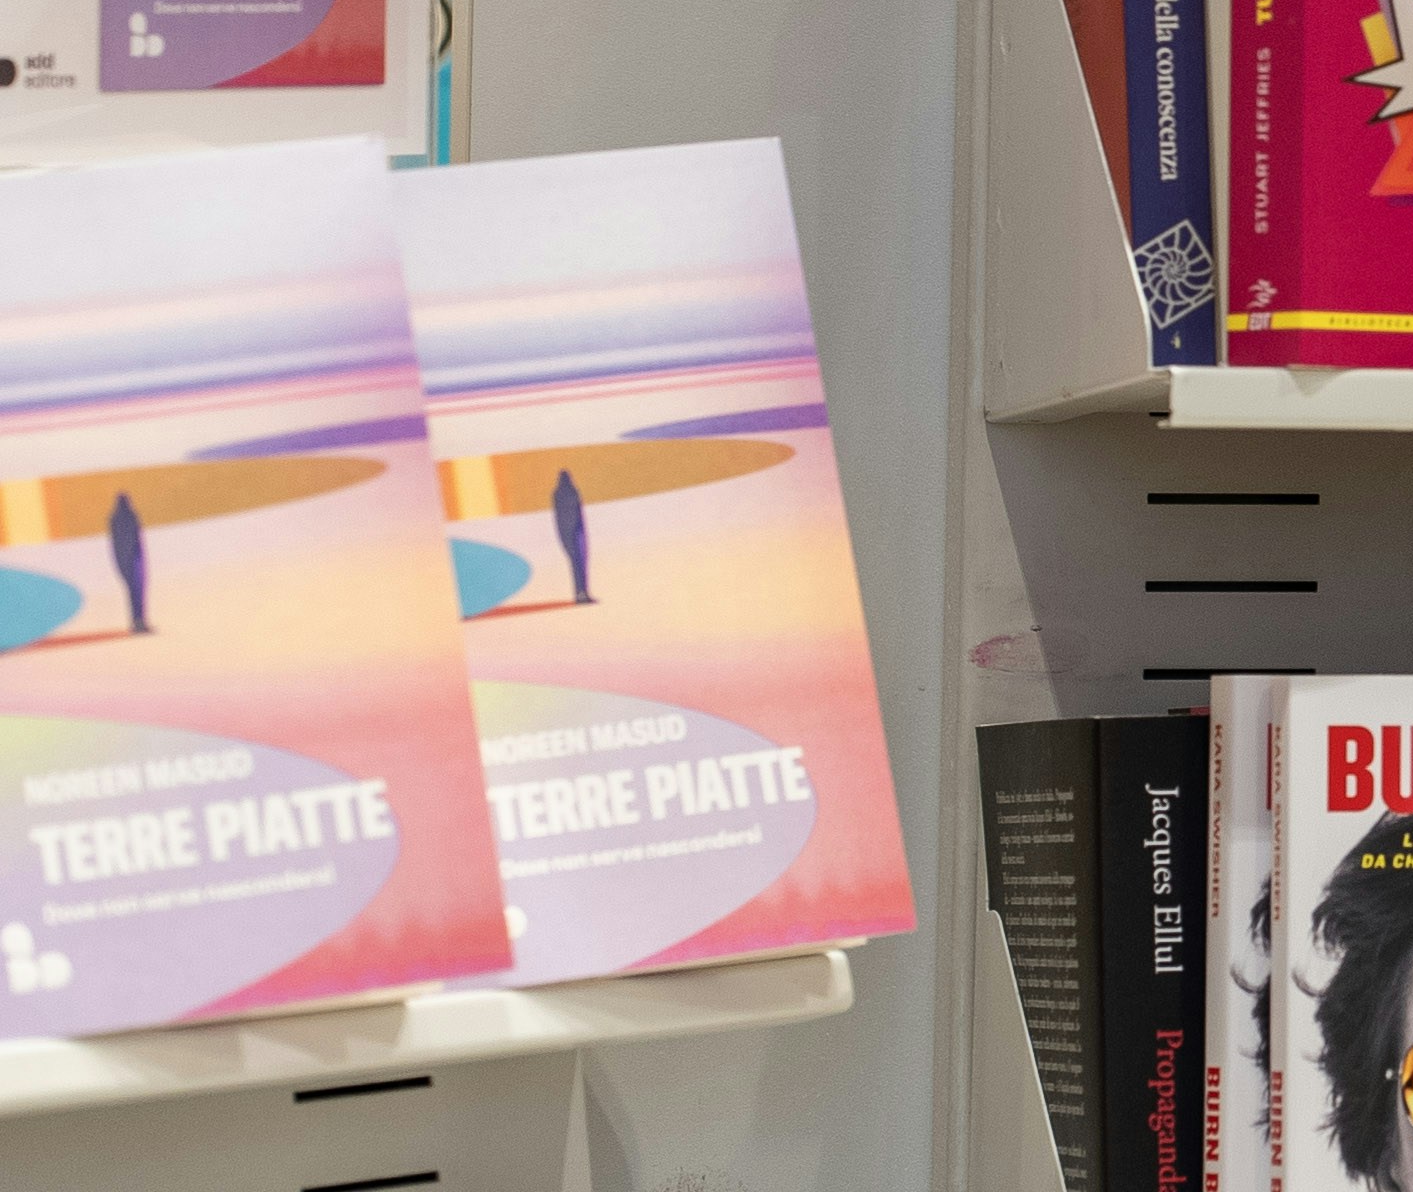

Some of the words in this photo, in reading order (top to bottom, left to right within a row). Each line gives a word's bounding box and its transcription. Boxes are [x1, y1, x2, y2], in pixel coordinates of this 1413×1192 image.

[1155, 47, 1179, 182] conoscenza
[1145, 783, 1181, 897] Jacques
[1361, 853, 1387, 869] DA
[1153, 903, 1185, 975] Ellul
